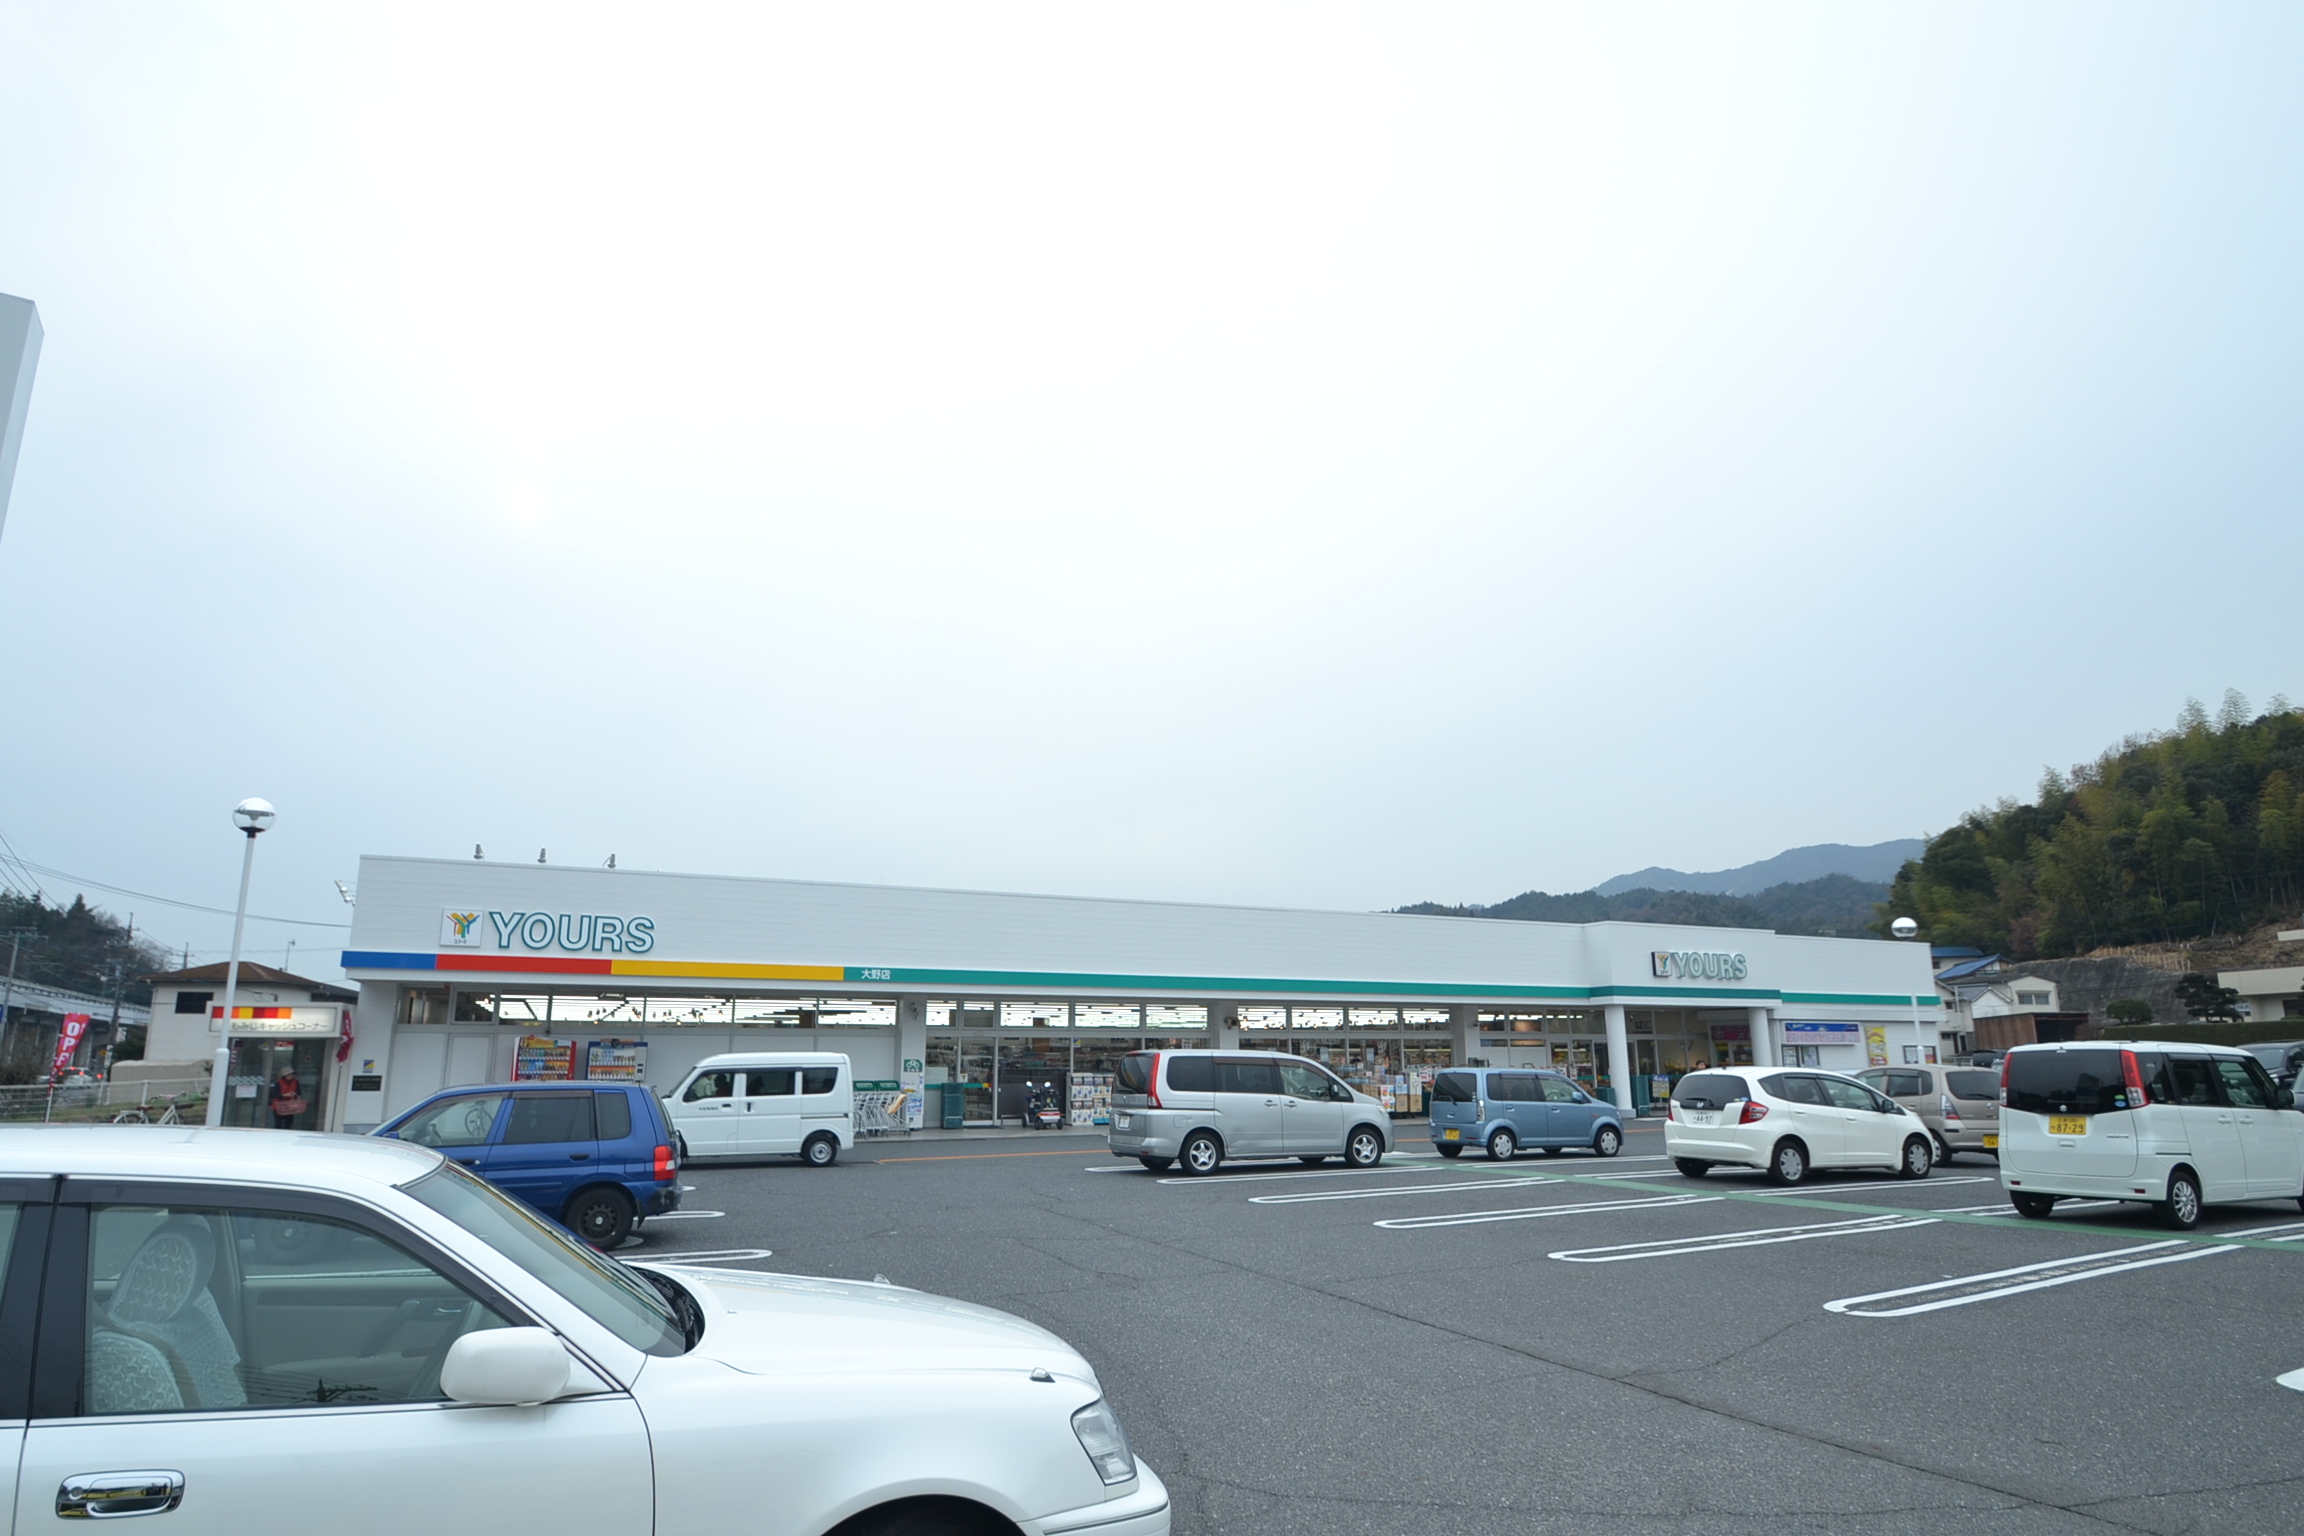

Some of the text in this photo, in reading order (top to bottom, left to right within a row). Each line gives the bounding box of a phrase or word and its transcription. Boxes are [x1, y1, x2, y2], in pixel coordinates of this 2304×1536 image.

[489, 911, 655, 954] YOURS
[1671, 951, 1748, 980] YOURS
[861, 968, 891, 980] 大野店
[231, 1021, 329, 1031] もみじキャッシュコーナー
[2056, 1123, 2084, 1134] 87-29
